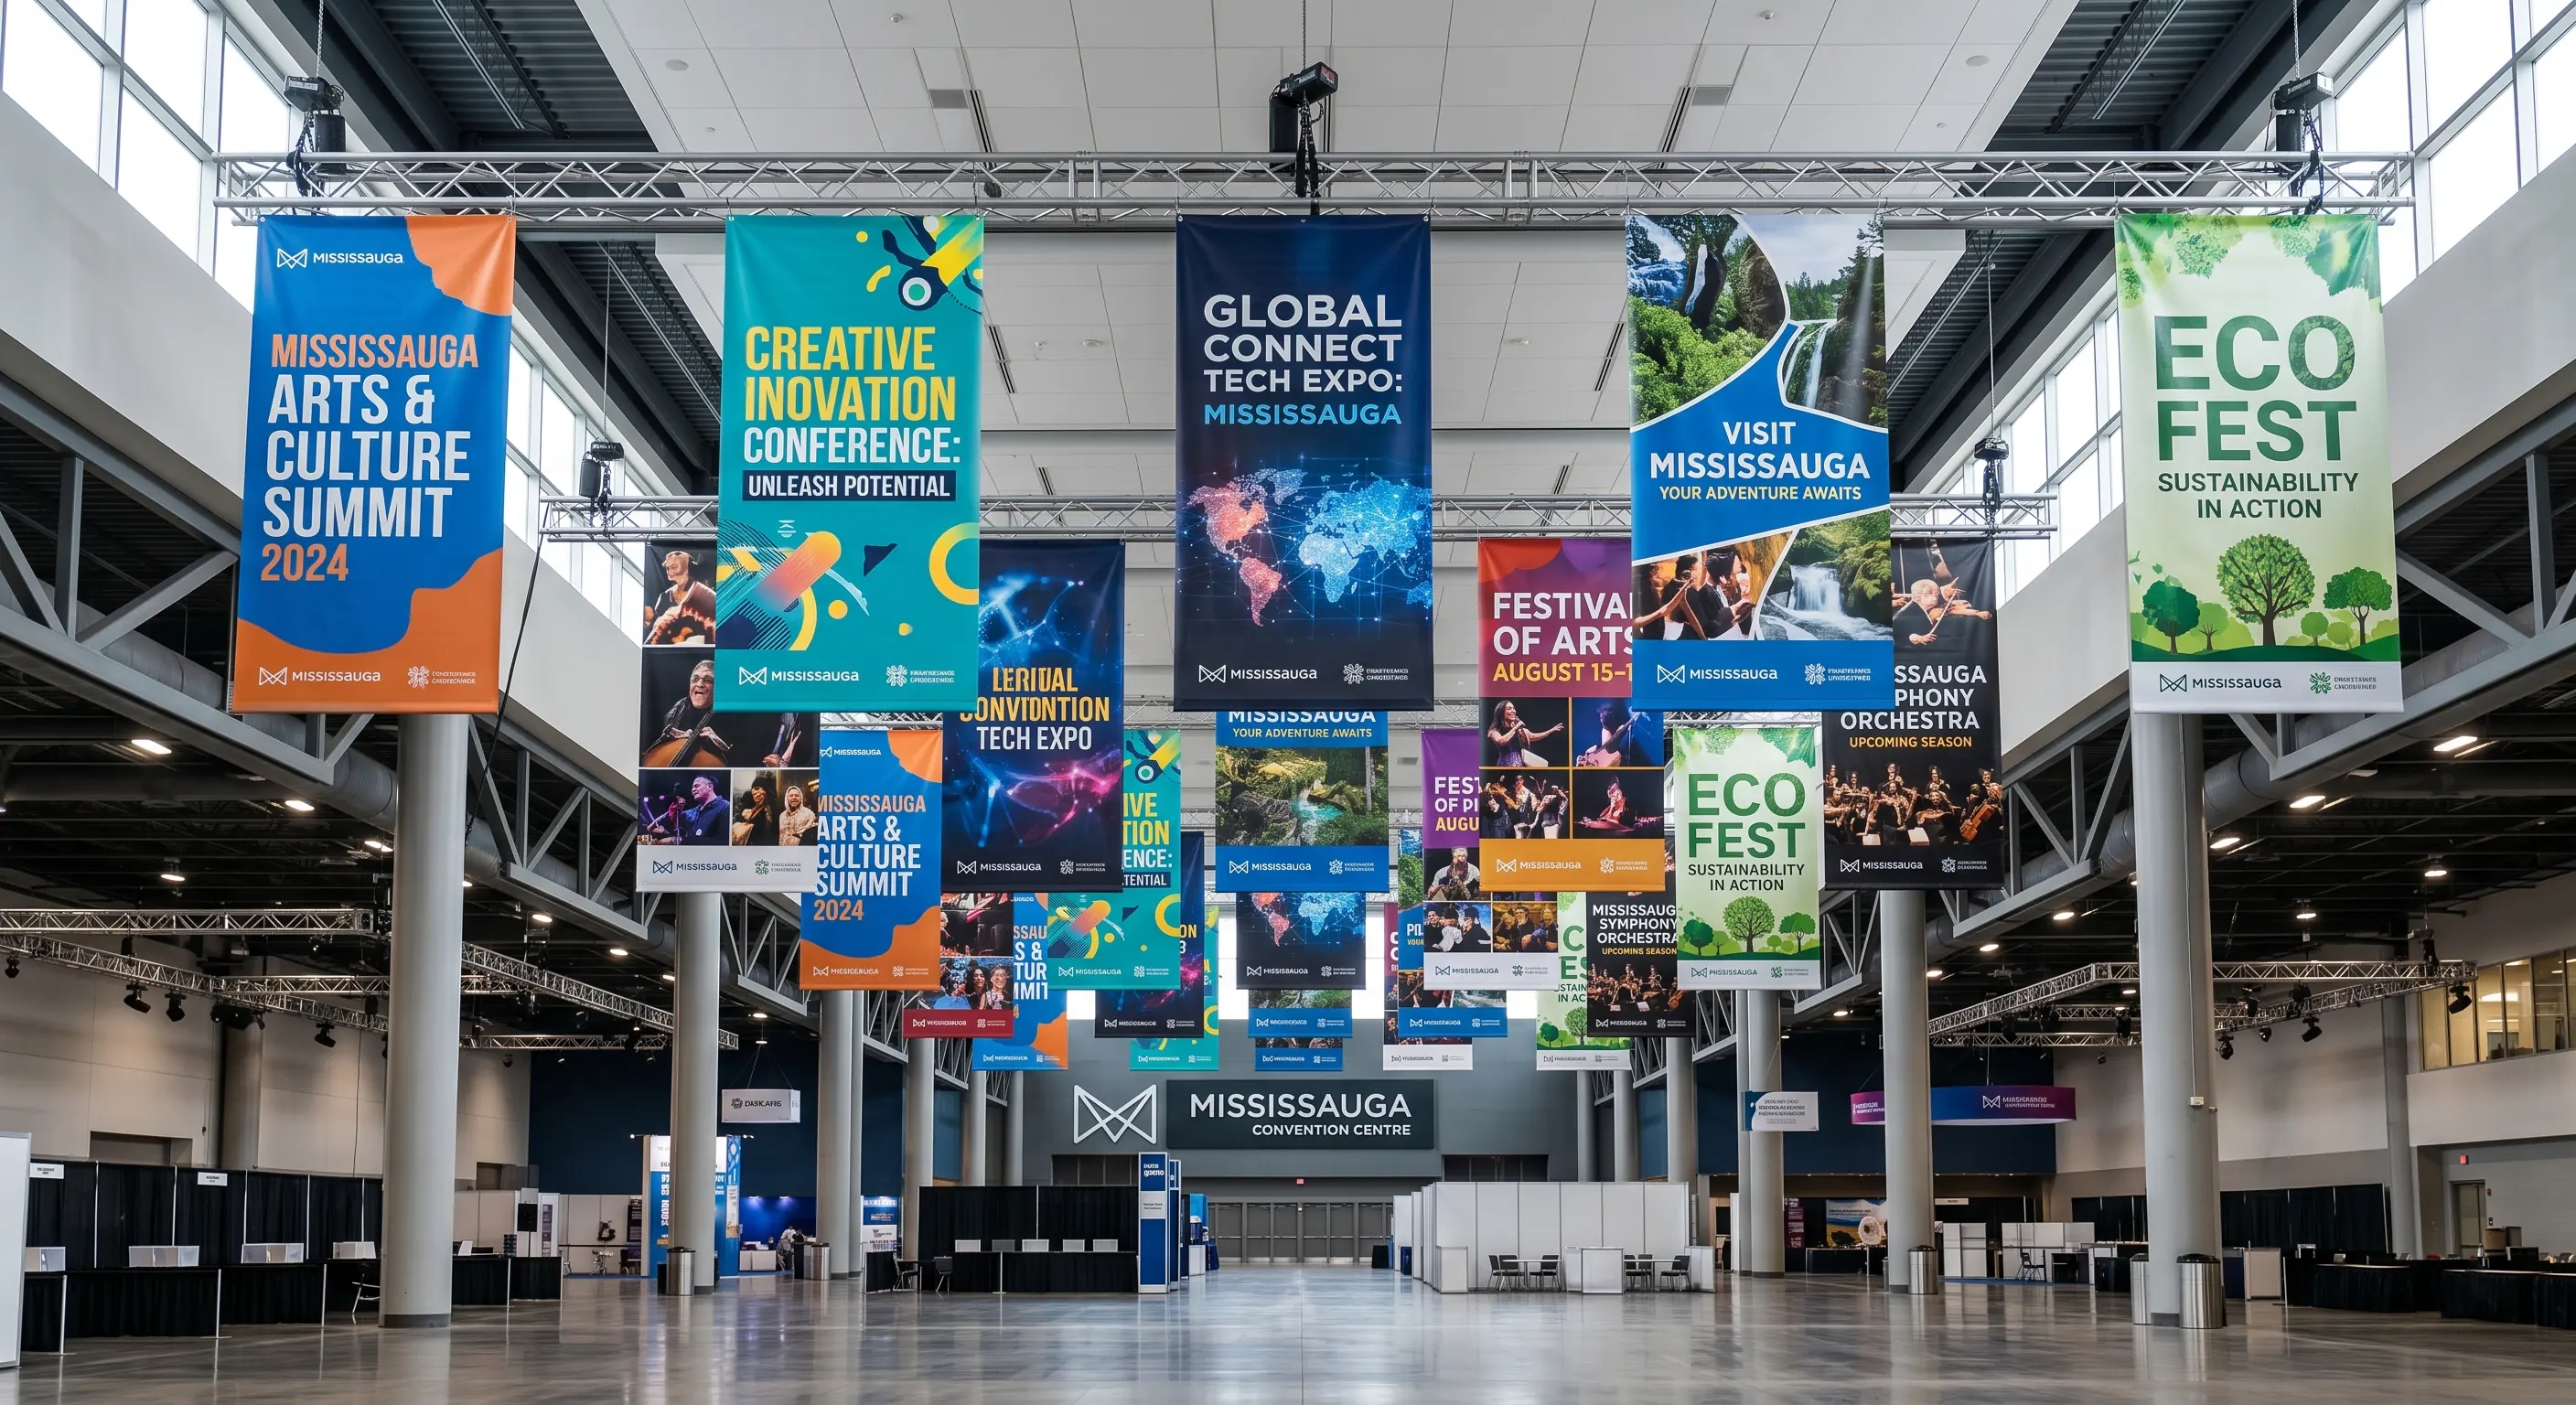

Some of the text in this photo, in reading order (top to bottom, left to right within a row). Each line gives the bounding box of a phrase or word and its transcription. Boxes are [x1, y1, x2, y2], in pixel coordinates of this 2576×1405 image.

[1204, 294, 1402, 327] GLOBAL
[272, 334, 478, 368] MISSISSAUGA
[746, 326, 936, 370] CREATIVE
[1204, 334, 1402, 362] CONNECT
[2154, 316, 2356, 391] ECO
[1204, 369, 1402, 392] TECH EXPO:
[267, 374, 435, 424] ARTS &
[745, 376, 956, 421] INOVATION
[1204, 403, 1402, 424] MISSISSAUGA
[1723, 422, 1796, 445] VISIT
[2157, 400, 2357, 461] FEST
[266, 430, 471, 480] CULTURE
[744, 427, 961, 463] CONFERENCE:
[1650, 452, 1871, 478] MISSISSAUGA
[748, 475, 950, 497] UNLEASH POTENTIAL
[1659, 486, 1862, 500] YOUR ADVENTURE AWAITS
[2158, 472, 2358, 492] SUSTAINABILITY
[263, 487, 453, 538] SUMMIT
[2197, 499, 2322, 519] IN ACTION
[261, 543, 349, 581] 2024
[1493, 592, 1633, 619] FESTIVA
[1493, 626, 1541, 656] OF
[1493, 662, 1633, 681] AUGUST 15-1
[1894, 665, 1987, 683] SSAUGA
[1894, 688, 1974, 707] PHONY
[1229, 711, 1377, 724] MISSISSAUGA
[1841, 711, 1980, 730] ORCHESTRA
[976, 726, 1092, 750] TECH EXPO
[1233, 728, 1372, 738] YOUR ADVENTURE AWAITS
[1850, 736, 1972, 748] UPCOMING SEASON
[818, 795, 926, 812] MISSISSAUGA
[1434, 798, 1458, 812] OF
[1688, 772, 1806, 817] ECO
[817, 815, 901, 841] ARTS &
[1435, 817, 1479, 831] AUGU
[1689, 821, 1806, 859] FEST
[817, 843, 921, 869] CULTURE
[1123, 874, 1167, 886] TENTIAL
[1688, 863, 1805, 876] SUSTAINABILITY
[814, 871, 913, 896] SUMMIT
[1710, 879, 1785, 891] IN ACTION
[813, 898, 864, 921] 2024
[1593, 904, 1676, 917] MISSISSAUG
[1599, 918, 1677, 930] SYMPHONY
[1596, 932, 1678, 944] ORCHESTRA
[1031, 941, 1043, 961] &
[1558, 993, 1568, 1003] IN
[1190, 1093, 1411, 1118] MISSISSAUGA
[1251, 1124, 1411, 1136] CONVENTION CENTRE
